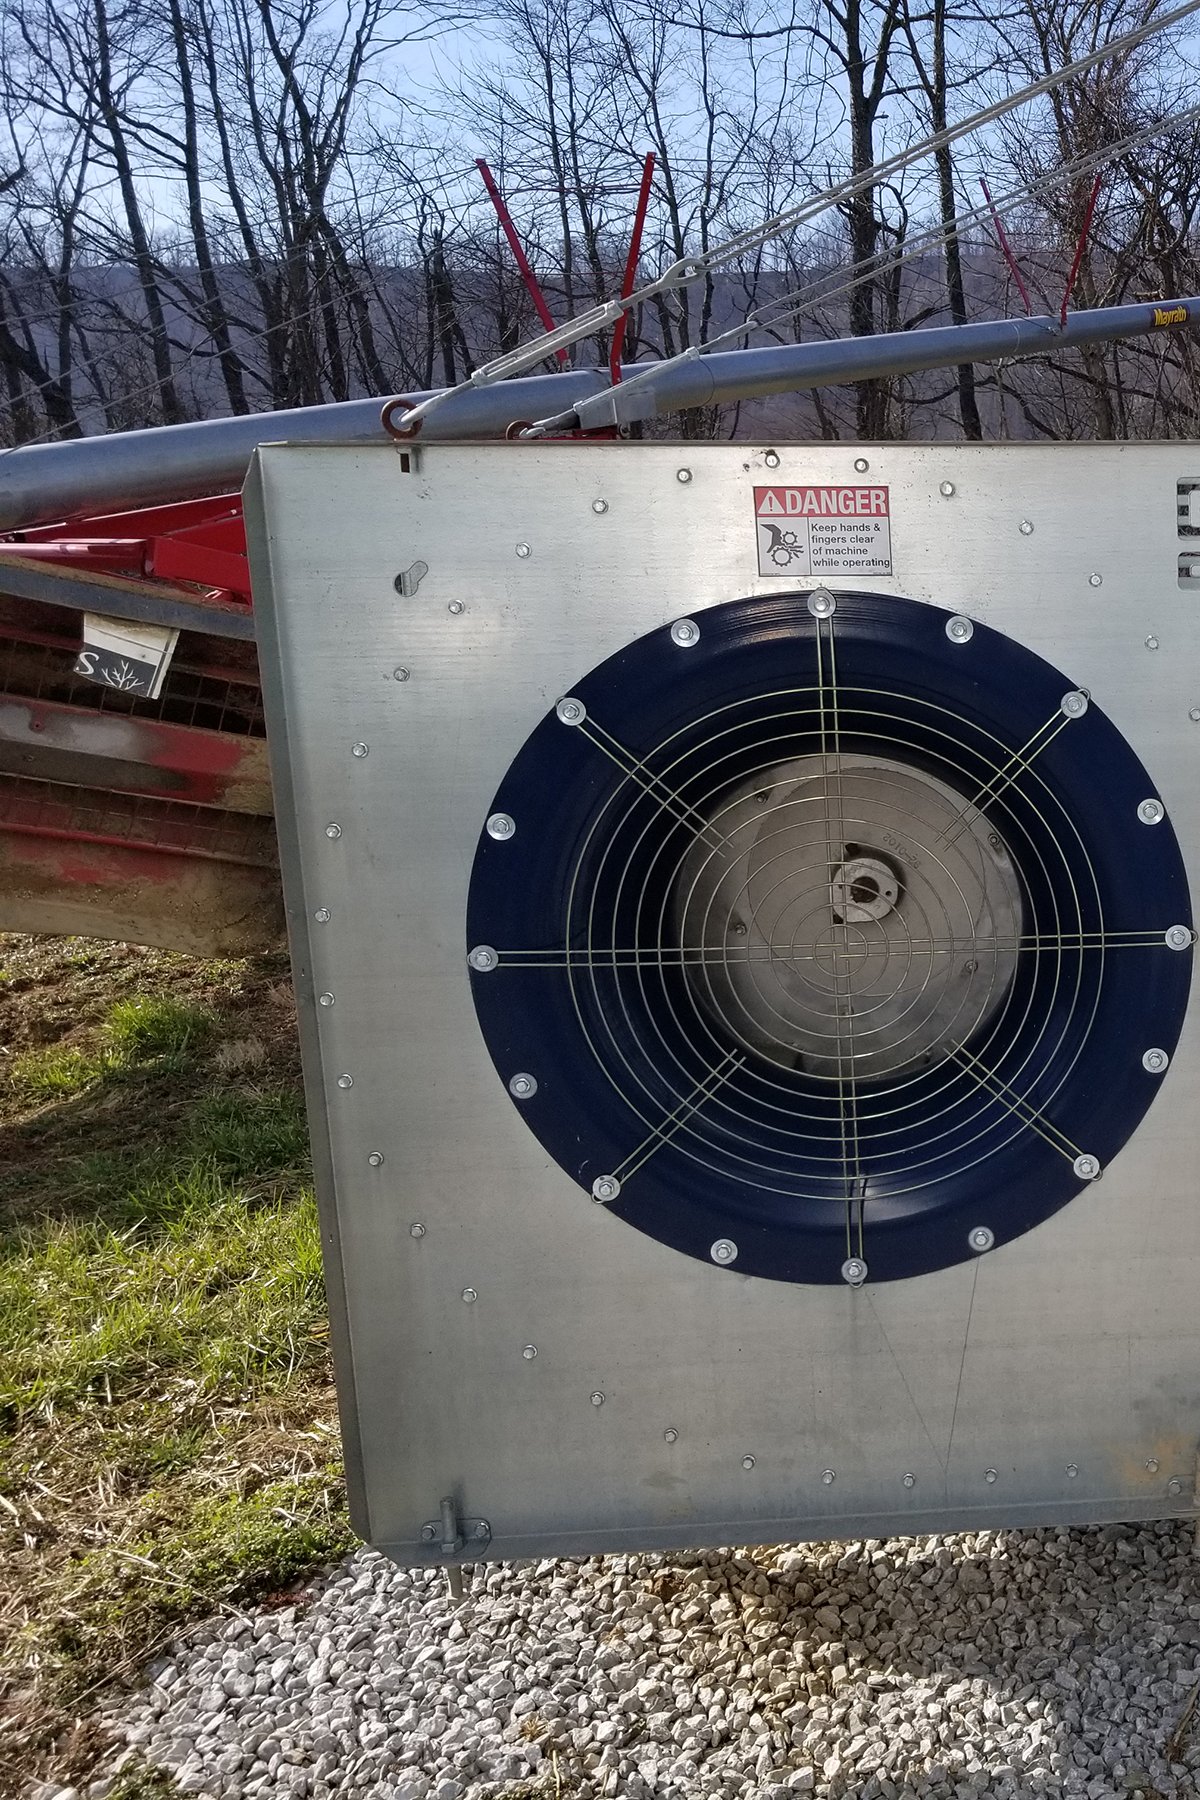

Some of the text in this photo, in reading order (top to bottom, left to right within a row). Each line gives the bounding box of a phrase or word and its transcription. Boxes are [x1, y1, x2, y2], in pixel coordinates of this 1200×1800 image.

[1153, 305, 1187, 327] Mayrath
[785, 489, 887, 514] DANGER
[811, 523, 881, 533] Keep hands &
[811, 535, 875, 544] fingers clear
[812, 547, 868, 555] of machine
[813, 558, 890, 568] while operating
